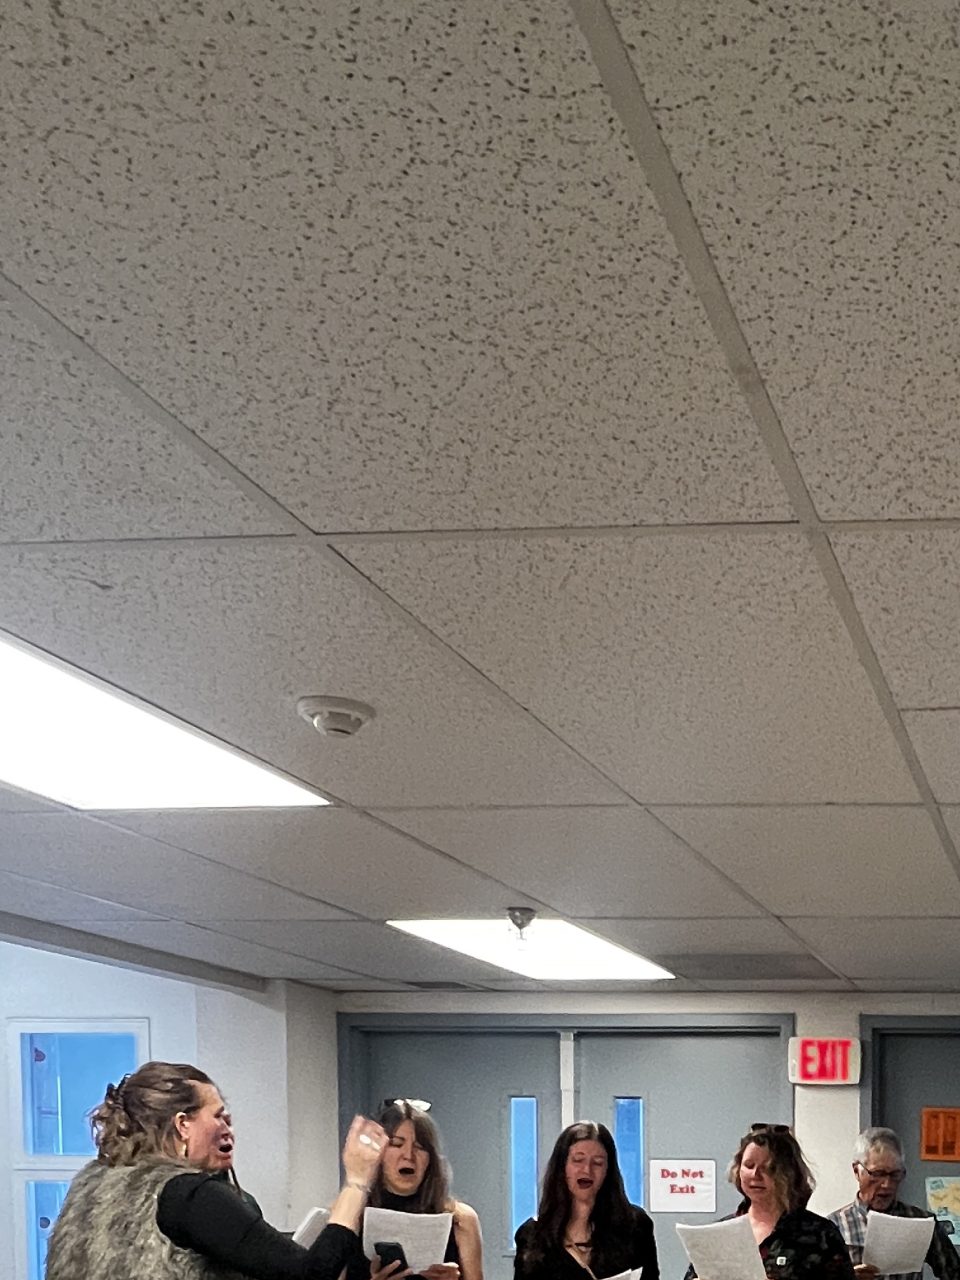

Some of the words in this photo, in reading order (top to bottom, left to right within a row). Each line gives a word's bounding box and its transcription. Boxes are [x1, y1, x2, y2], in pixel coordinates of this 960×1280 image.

[801, 1039, 852, 1081] EXIT
[661, 1168, 678, 1179] Do
[681, 1168, 704, 1179] Not
[670, 1184, 696, 1194] Exit
